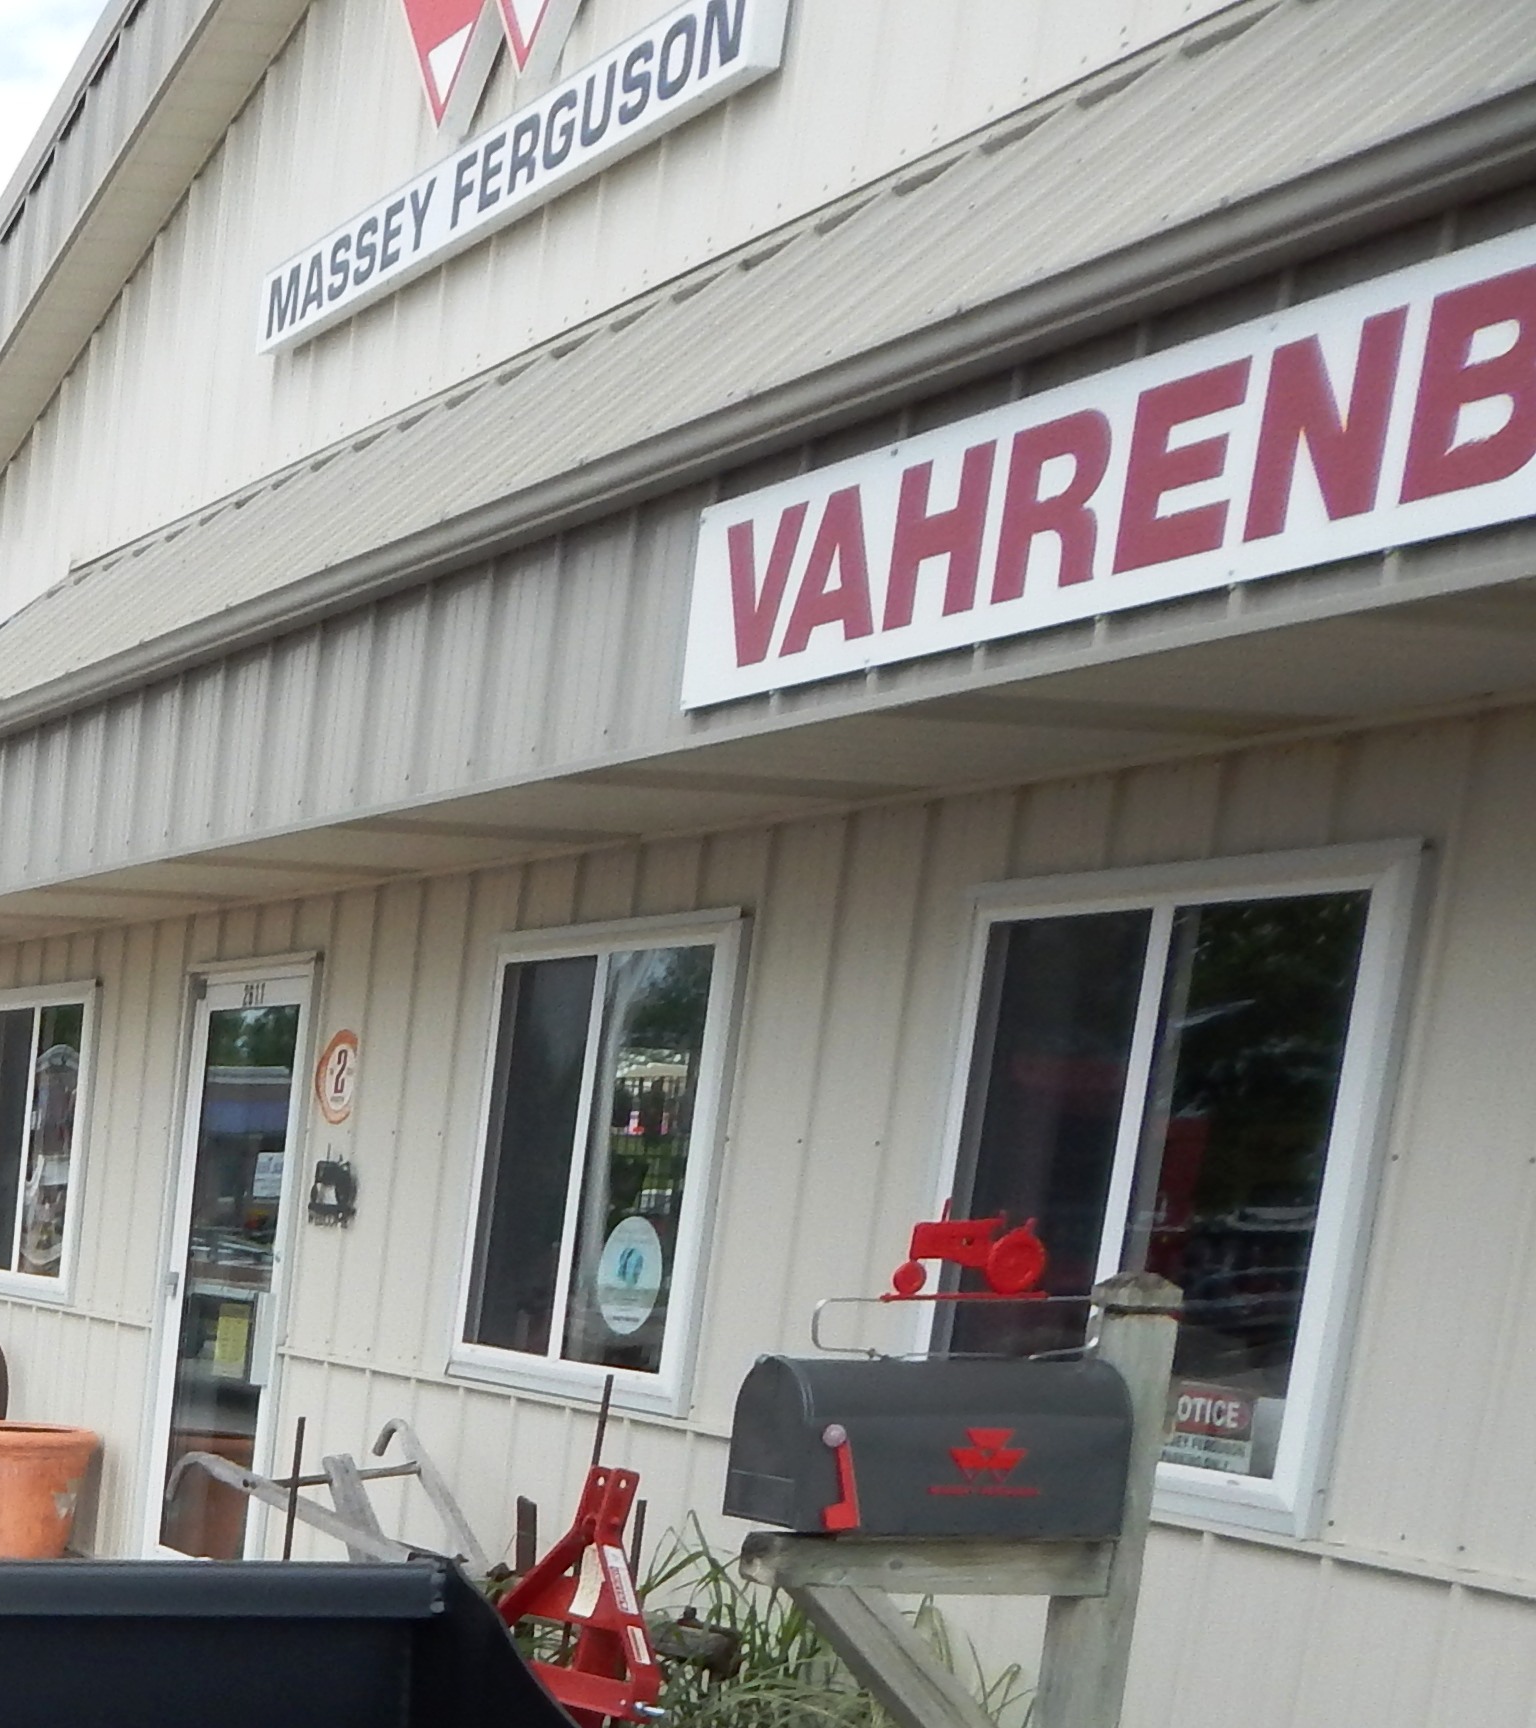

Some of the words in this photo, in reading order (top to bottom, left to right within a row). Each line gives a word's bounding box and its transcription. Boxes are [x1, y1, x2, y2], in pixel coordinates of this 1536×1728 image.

[265, 177, 437, 339] MASSEY
[449, 0, 747, 229] FERGUSON
[726, 262, 1536, 669] VAHRENB
[333, 1049, 348, 1094] 2
[1177, 1394, 1241, 1429] OTICE
